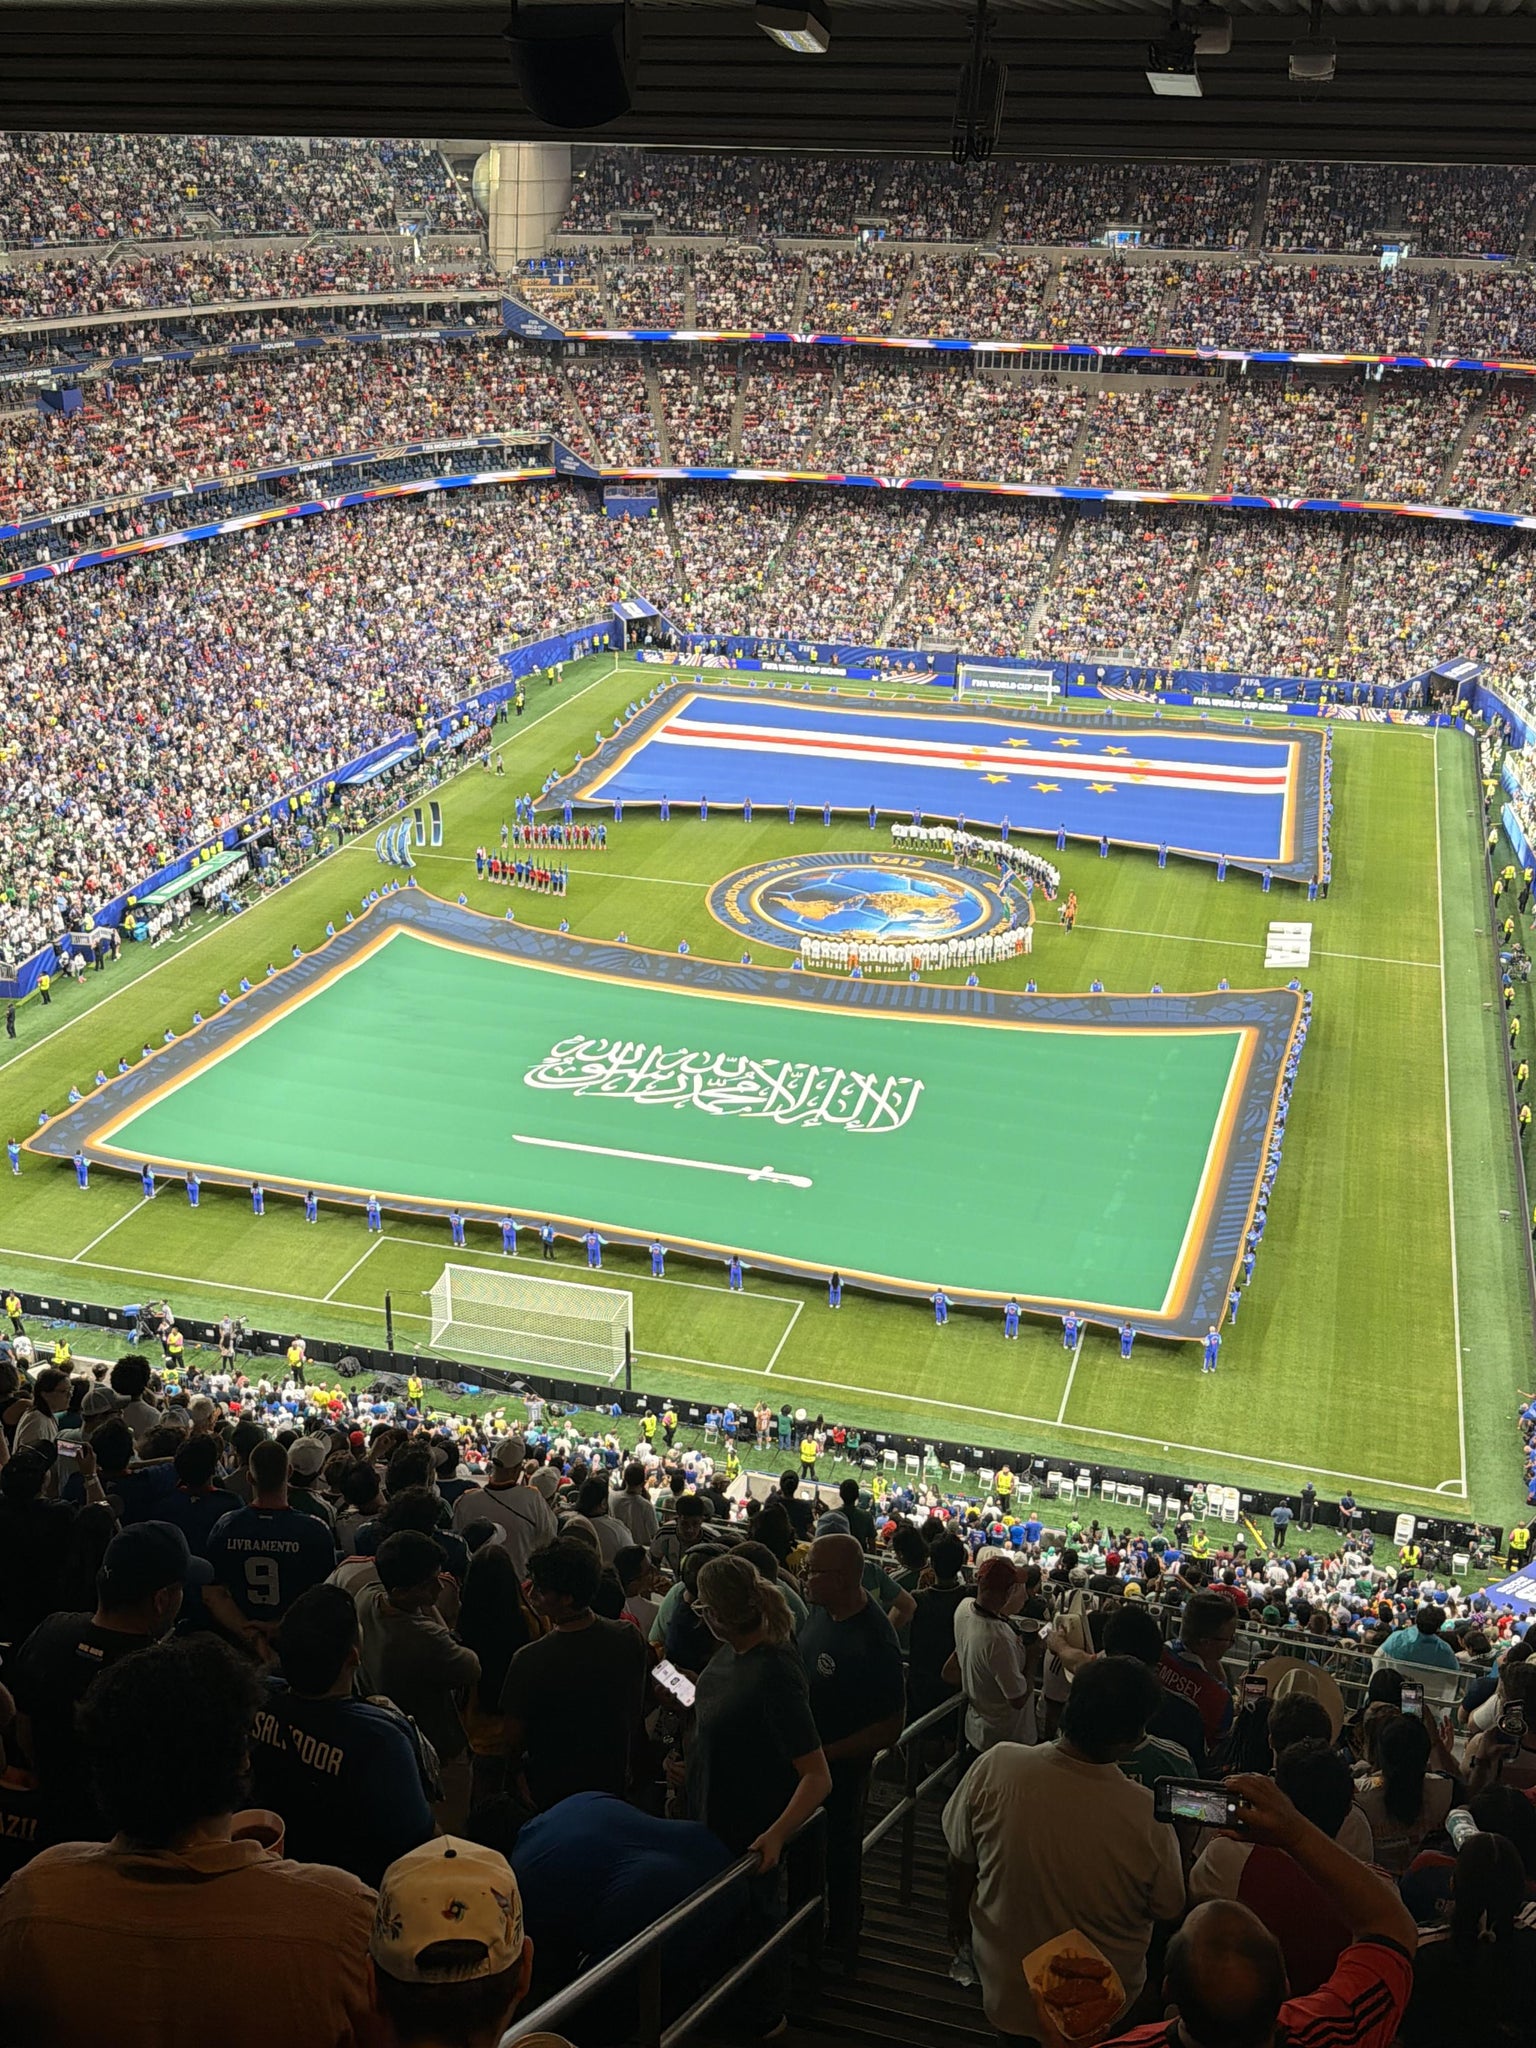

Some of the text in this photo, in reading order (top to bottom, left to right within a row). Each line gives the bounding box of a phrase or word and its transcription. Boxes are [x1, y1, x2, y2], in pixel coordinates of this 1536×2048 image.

[261, 341, 296, 350] HOUSTON
[299, 461, 333, 472] HOUSTON
[50, 509, 91, 524] HOUSTON
[762, 662, 777, 670] FIFA
[778, 664, 805, 673] WORLD
[804, 665, 821, 673] CUP
[971, 679, 989, 688] FIFA
[989, 680, 1017, 690] WORLD
[1240, 678, 1261, 687] FIFA
[1193, 696, 1212, 706] FIFA
[1211, 698, 1241, 708] WORLD
[1241, 701, 1258, 709] CUP
[871, 856, 926, 868] FIFA
[731, 867, 771, 890] WORLD
[226, 1538, 301, 1553] LIVRAMENTO
[243, 1556, 281, 1606] 9
